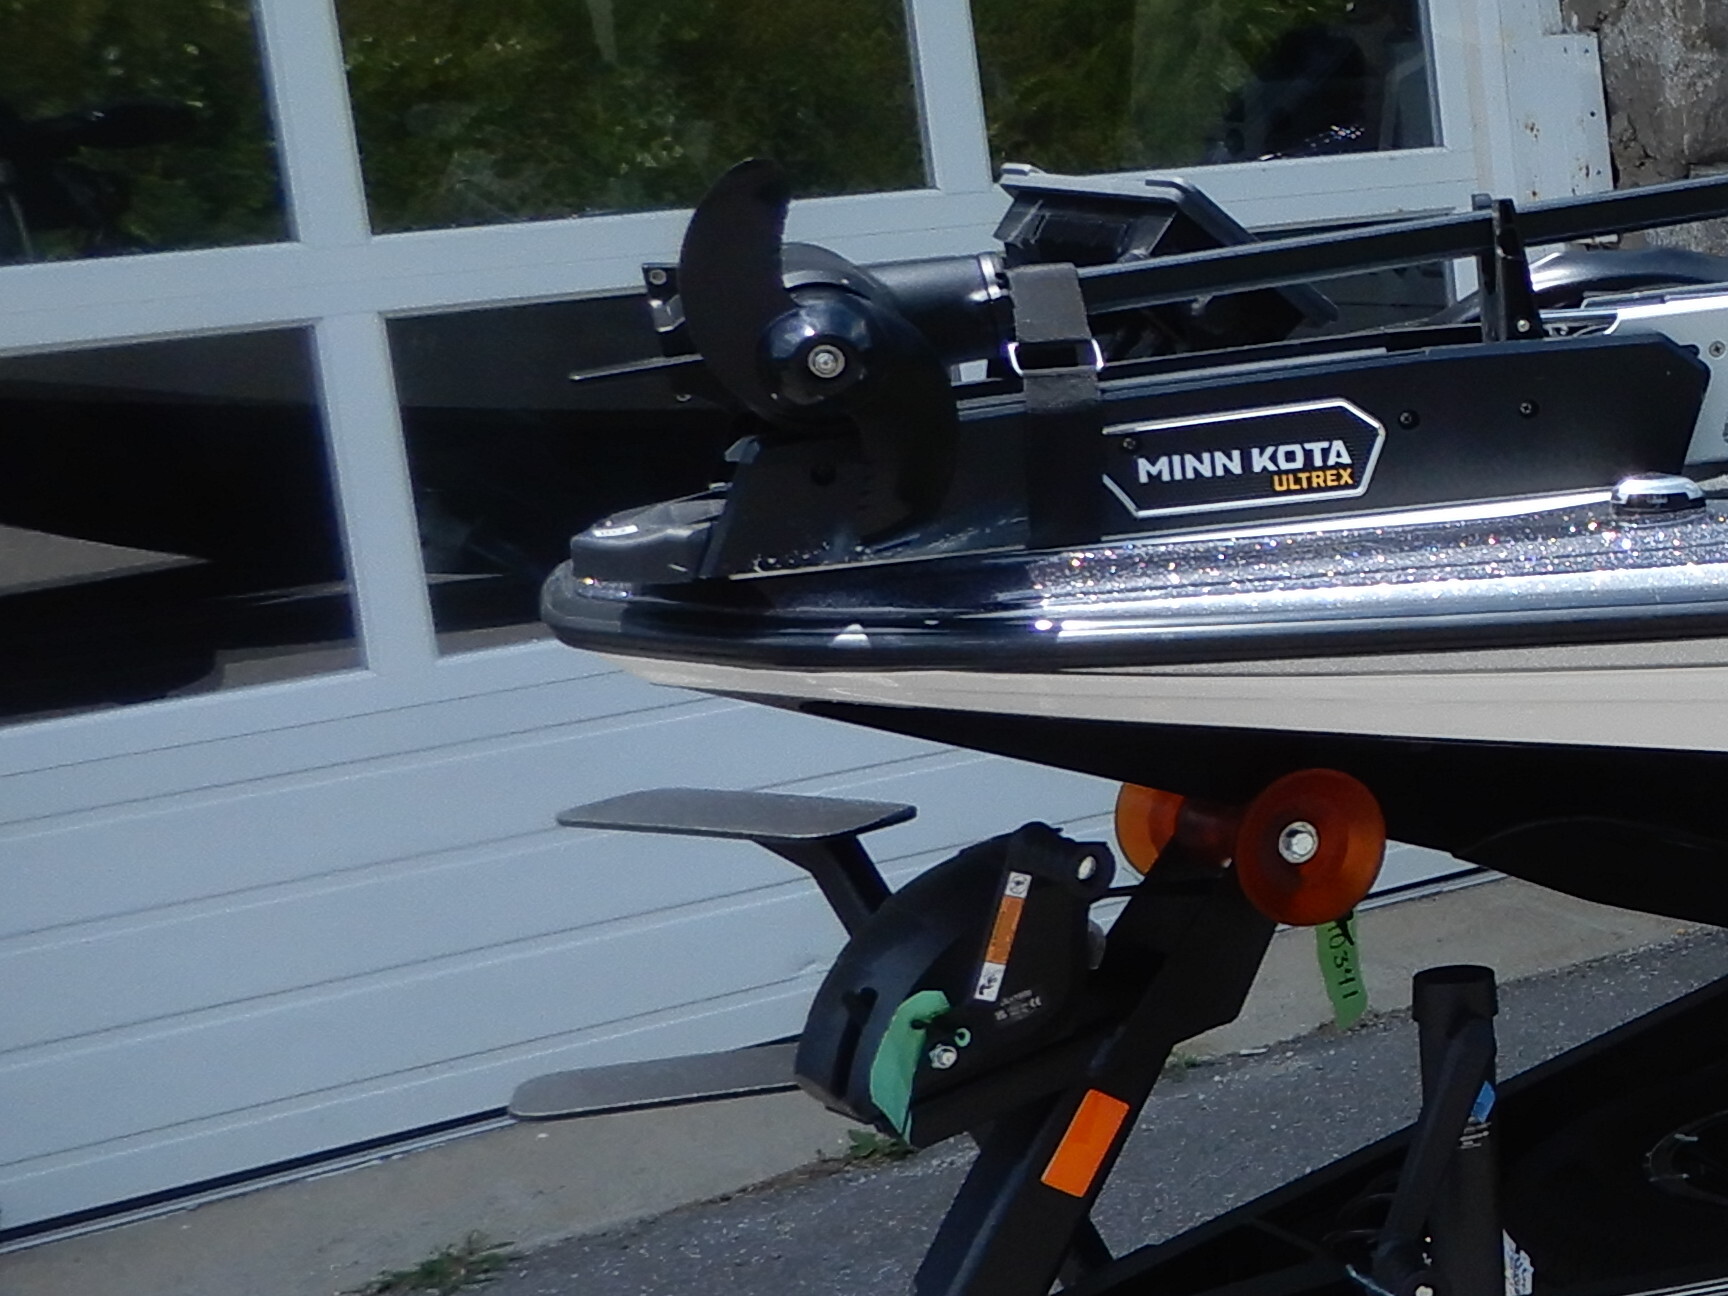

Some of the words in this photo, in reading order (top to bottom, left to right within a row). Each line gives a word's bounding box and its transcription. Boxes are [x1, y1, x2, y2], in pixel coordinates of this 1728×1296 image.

[1137, 449, 1241, 484] MINN
[1251, 439, 1352, 473] KOTA
[1272, 468, 1354, 492] ULTREX
